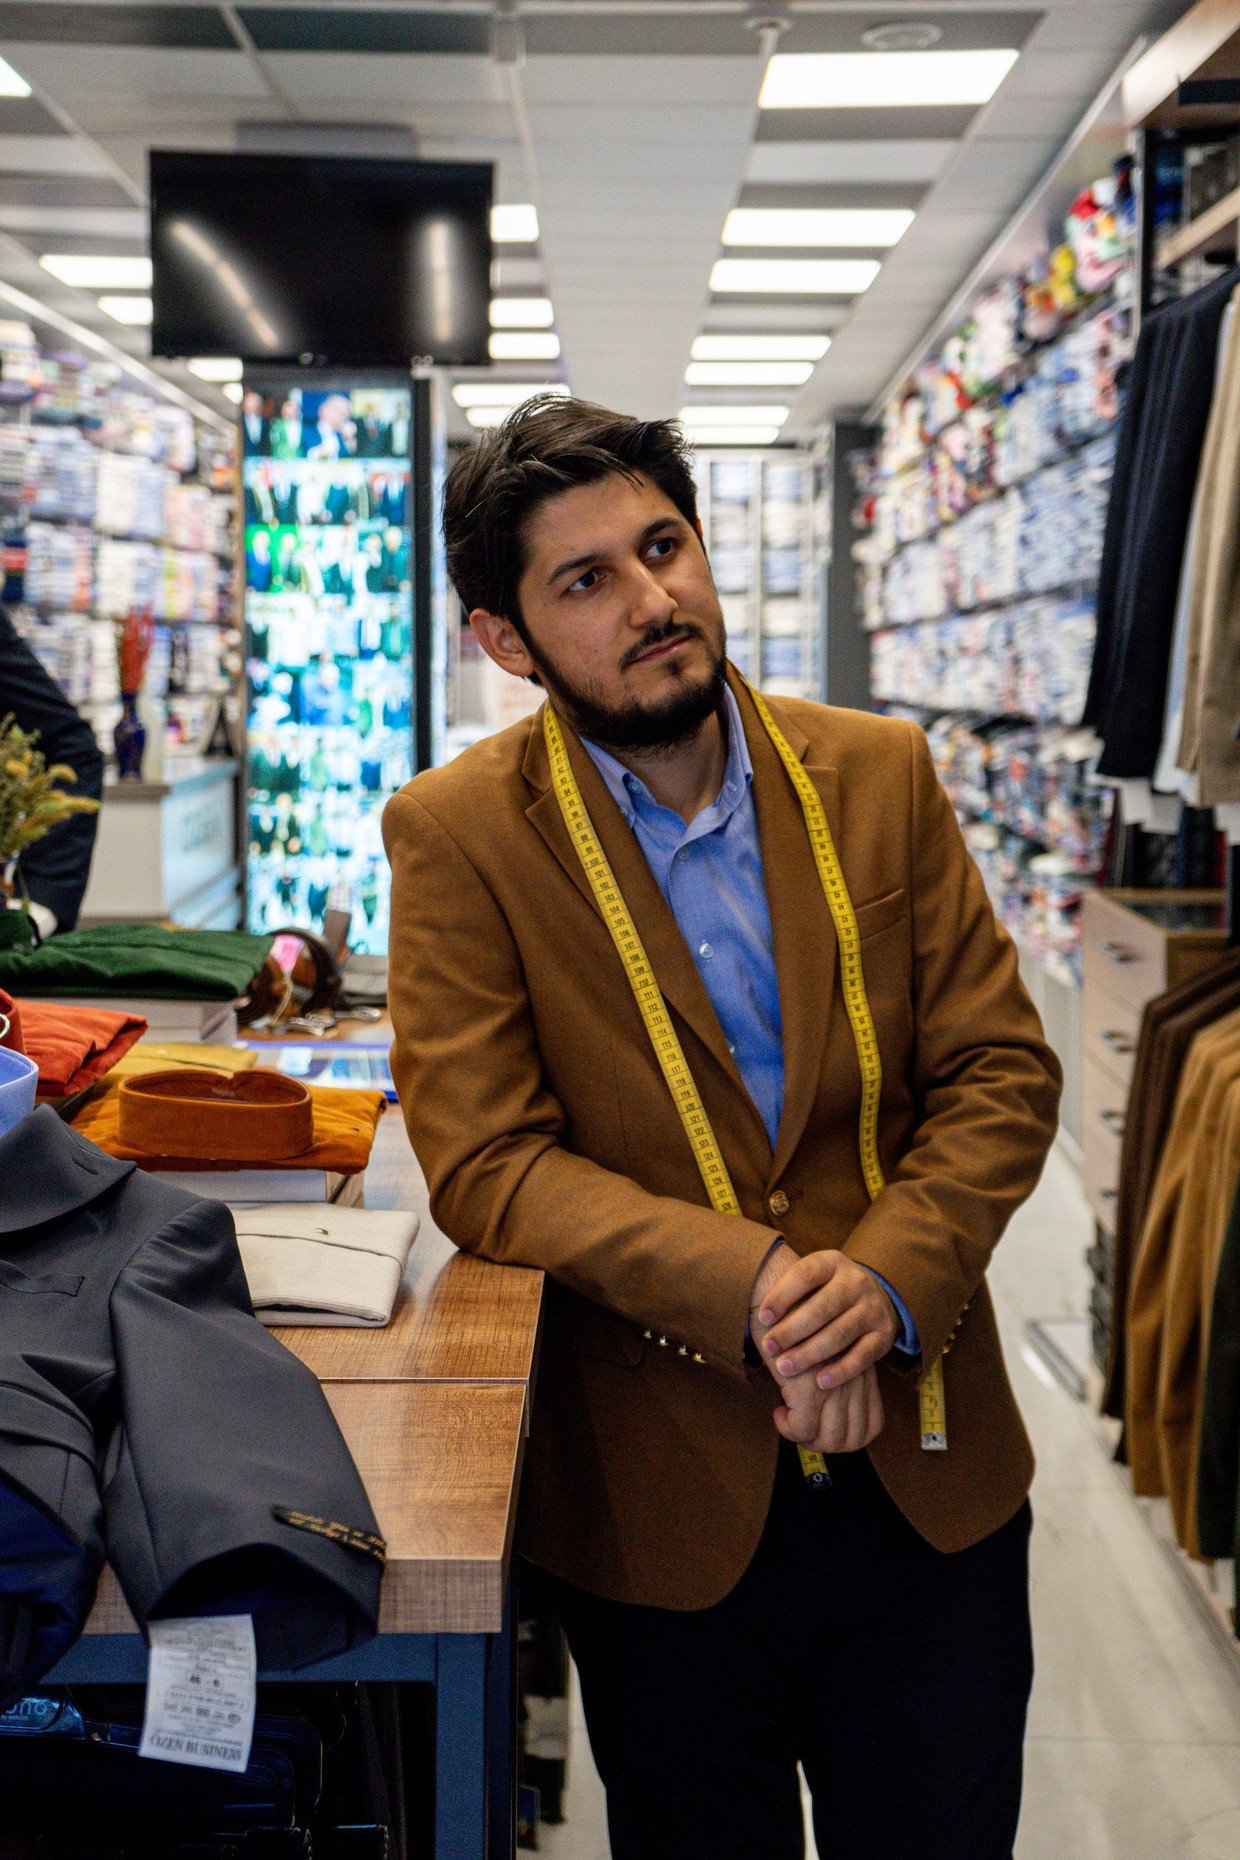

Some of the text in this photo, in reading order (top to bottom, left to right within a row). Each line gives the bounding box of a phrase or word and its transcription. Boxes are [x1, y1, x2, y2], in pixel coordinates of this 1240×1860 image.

[564, 788, 570, 796] 94
[568, 799, 575, 807] 95
[572, 810, 579, 818] 96
[576, 822, 583, 830] 97
[586, 845, 593, 854] 99
[590, 857, 599, 866] 100
[595, 869, 604, 878] 101
[600, 881, 610, 890] 102
[605, 893, 615, 901] 103
[610, 905, 620, 914] 104
[615, 917, 625, 926] 105
[619, 929, 630, 938] 106
[624, 942, 635, 950] 107
[630, 953, 640, 962] 108
[634, 966, 645, 974] 109
[639, 978, 649, 987] 110
[644, 991, 654, 999] 111
[648, 1003, 658, 1012] 112
[652, 1015, 662, 1023] 113
[657, 1027, 667, 1035] 114
[662, 1040, 672, 1048] 115
[667, 1052, 676, 1061] 116
[672, 1065, 681, 1073] 117
[676, 1077, 686, 1086] 118
[681, 1090, 691, 1099] 119
[685, 1102, 695, 1111] 120
[690, 1115, 700, 1123] 121
[694, 1126, 705, 1135] 122
[699, 1138, 709, 1147] 123
[703, 1151, 713, 1160] 124
[708, 1163, 718, 1172] 125
[712, 1176, 723, 1185] 126
[717, 1189, 727, 1197] 127
[722, 1201, 732, 1210] 128
[186, 1741, 242, 1760] BUSINESS
